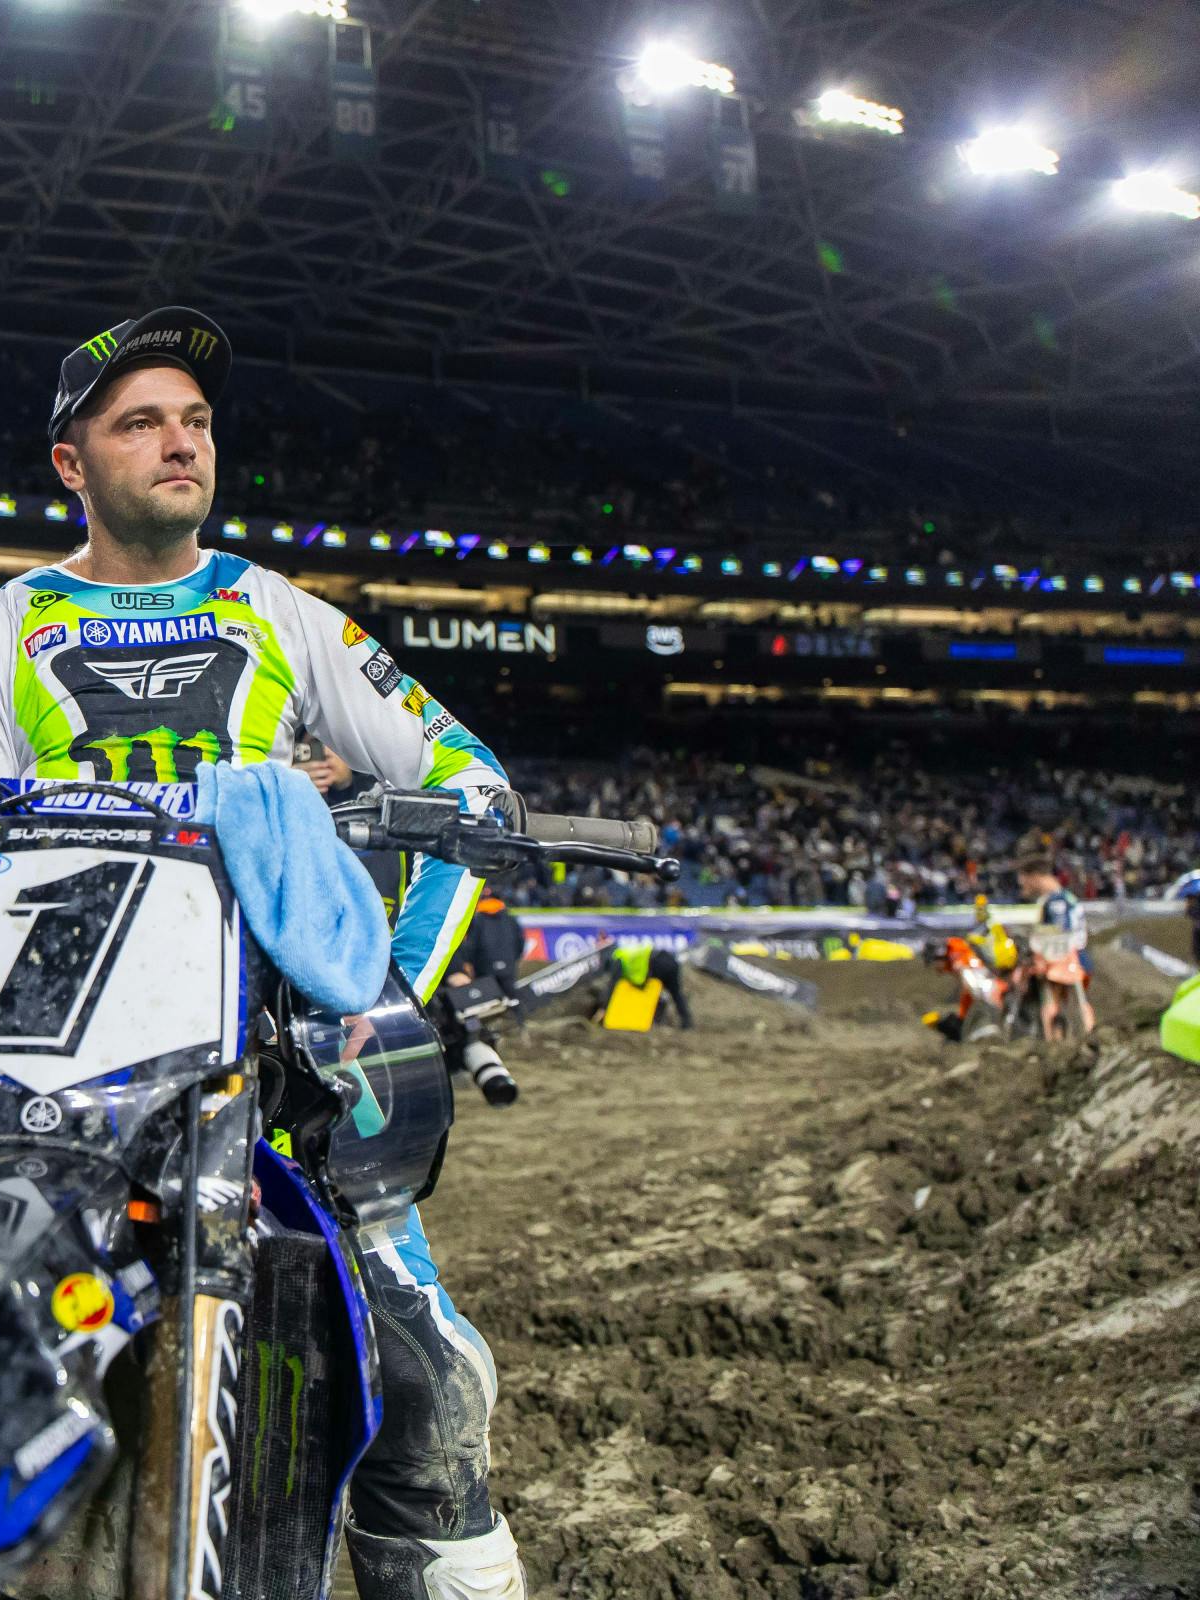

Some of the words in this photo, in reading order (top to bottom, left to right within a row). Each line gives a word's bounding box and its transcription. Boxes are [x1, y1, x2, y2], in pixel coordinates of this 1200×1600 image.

[111, 592, 174, 610] WPS
[28, 625, 65, 655] 100%
[112, 615, 215, 644] YAMAHA
[403, 616, 556, 653] LUMEN
[7, 827, 152, 843] SUPERCROSS
